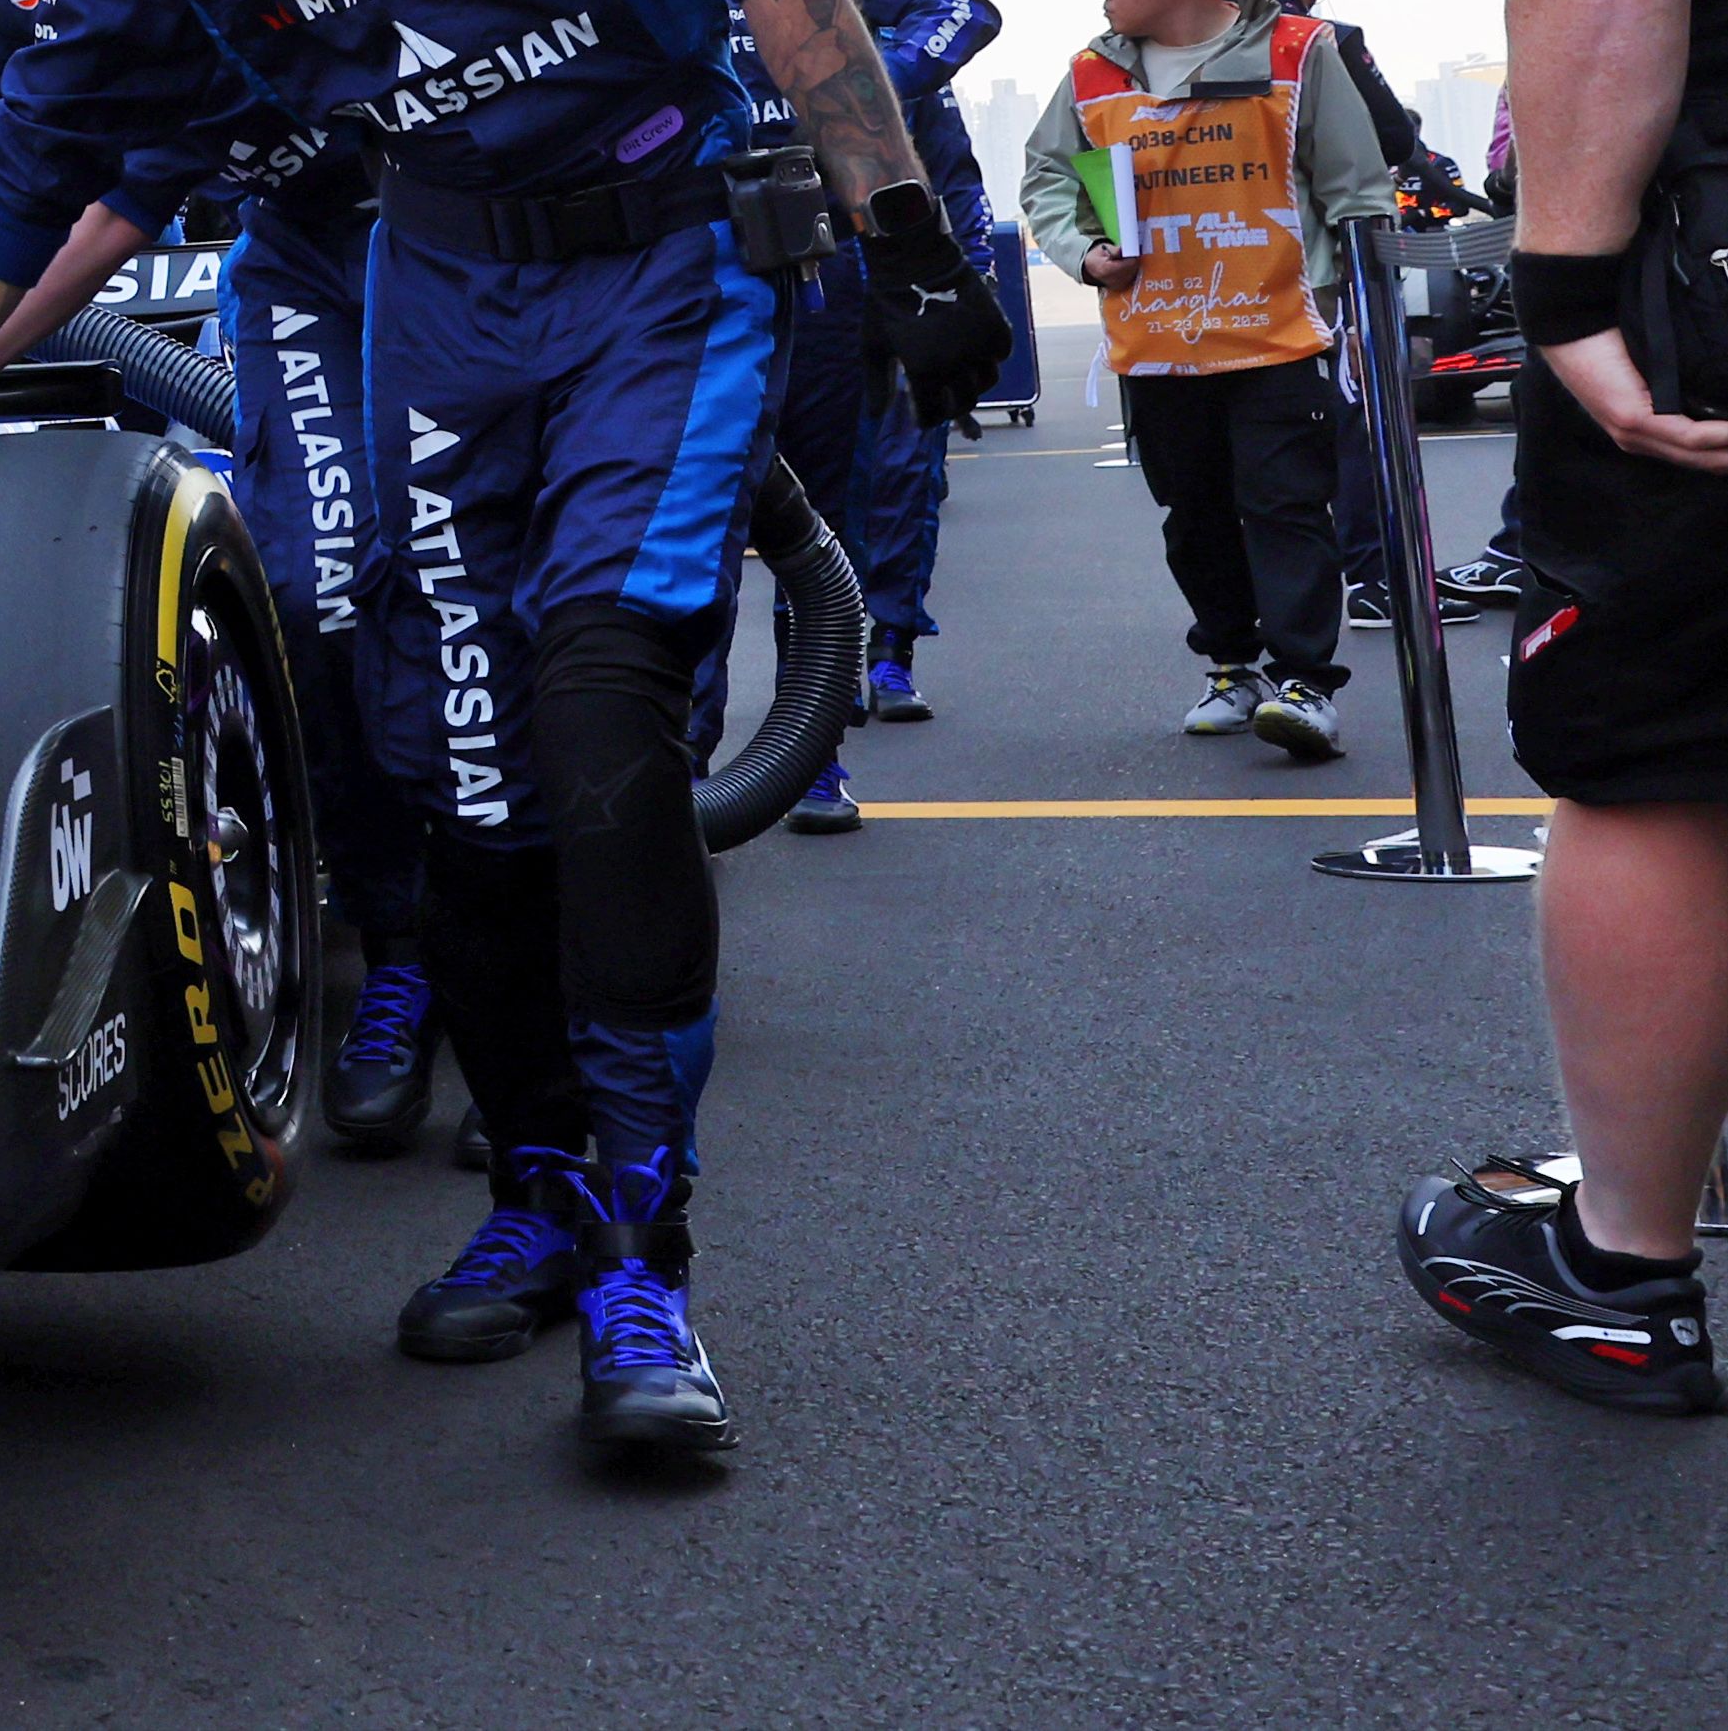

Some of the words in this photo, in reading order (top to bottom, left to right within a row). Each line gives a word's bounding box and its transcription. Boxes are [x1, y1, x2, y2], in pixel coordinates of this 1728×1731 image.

[641, 115, 674, 143] Crew
[1242, 162, 1270, 181] F1
[1196, 210, 1246, 231] ALL
[1145, 278, 1174, 291] RND
[276, 348, 358, 635] ATLASSIAN
[407, 485, 511, 831] ATLASSIAN
[168, 880, 249, 1172] ZERO
[57, 1011, 128, 1123] SCORES
